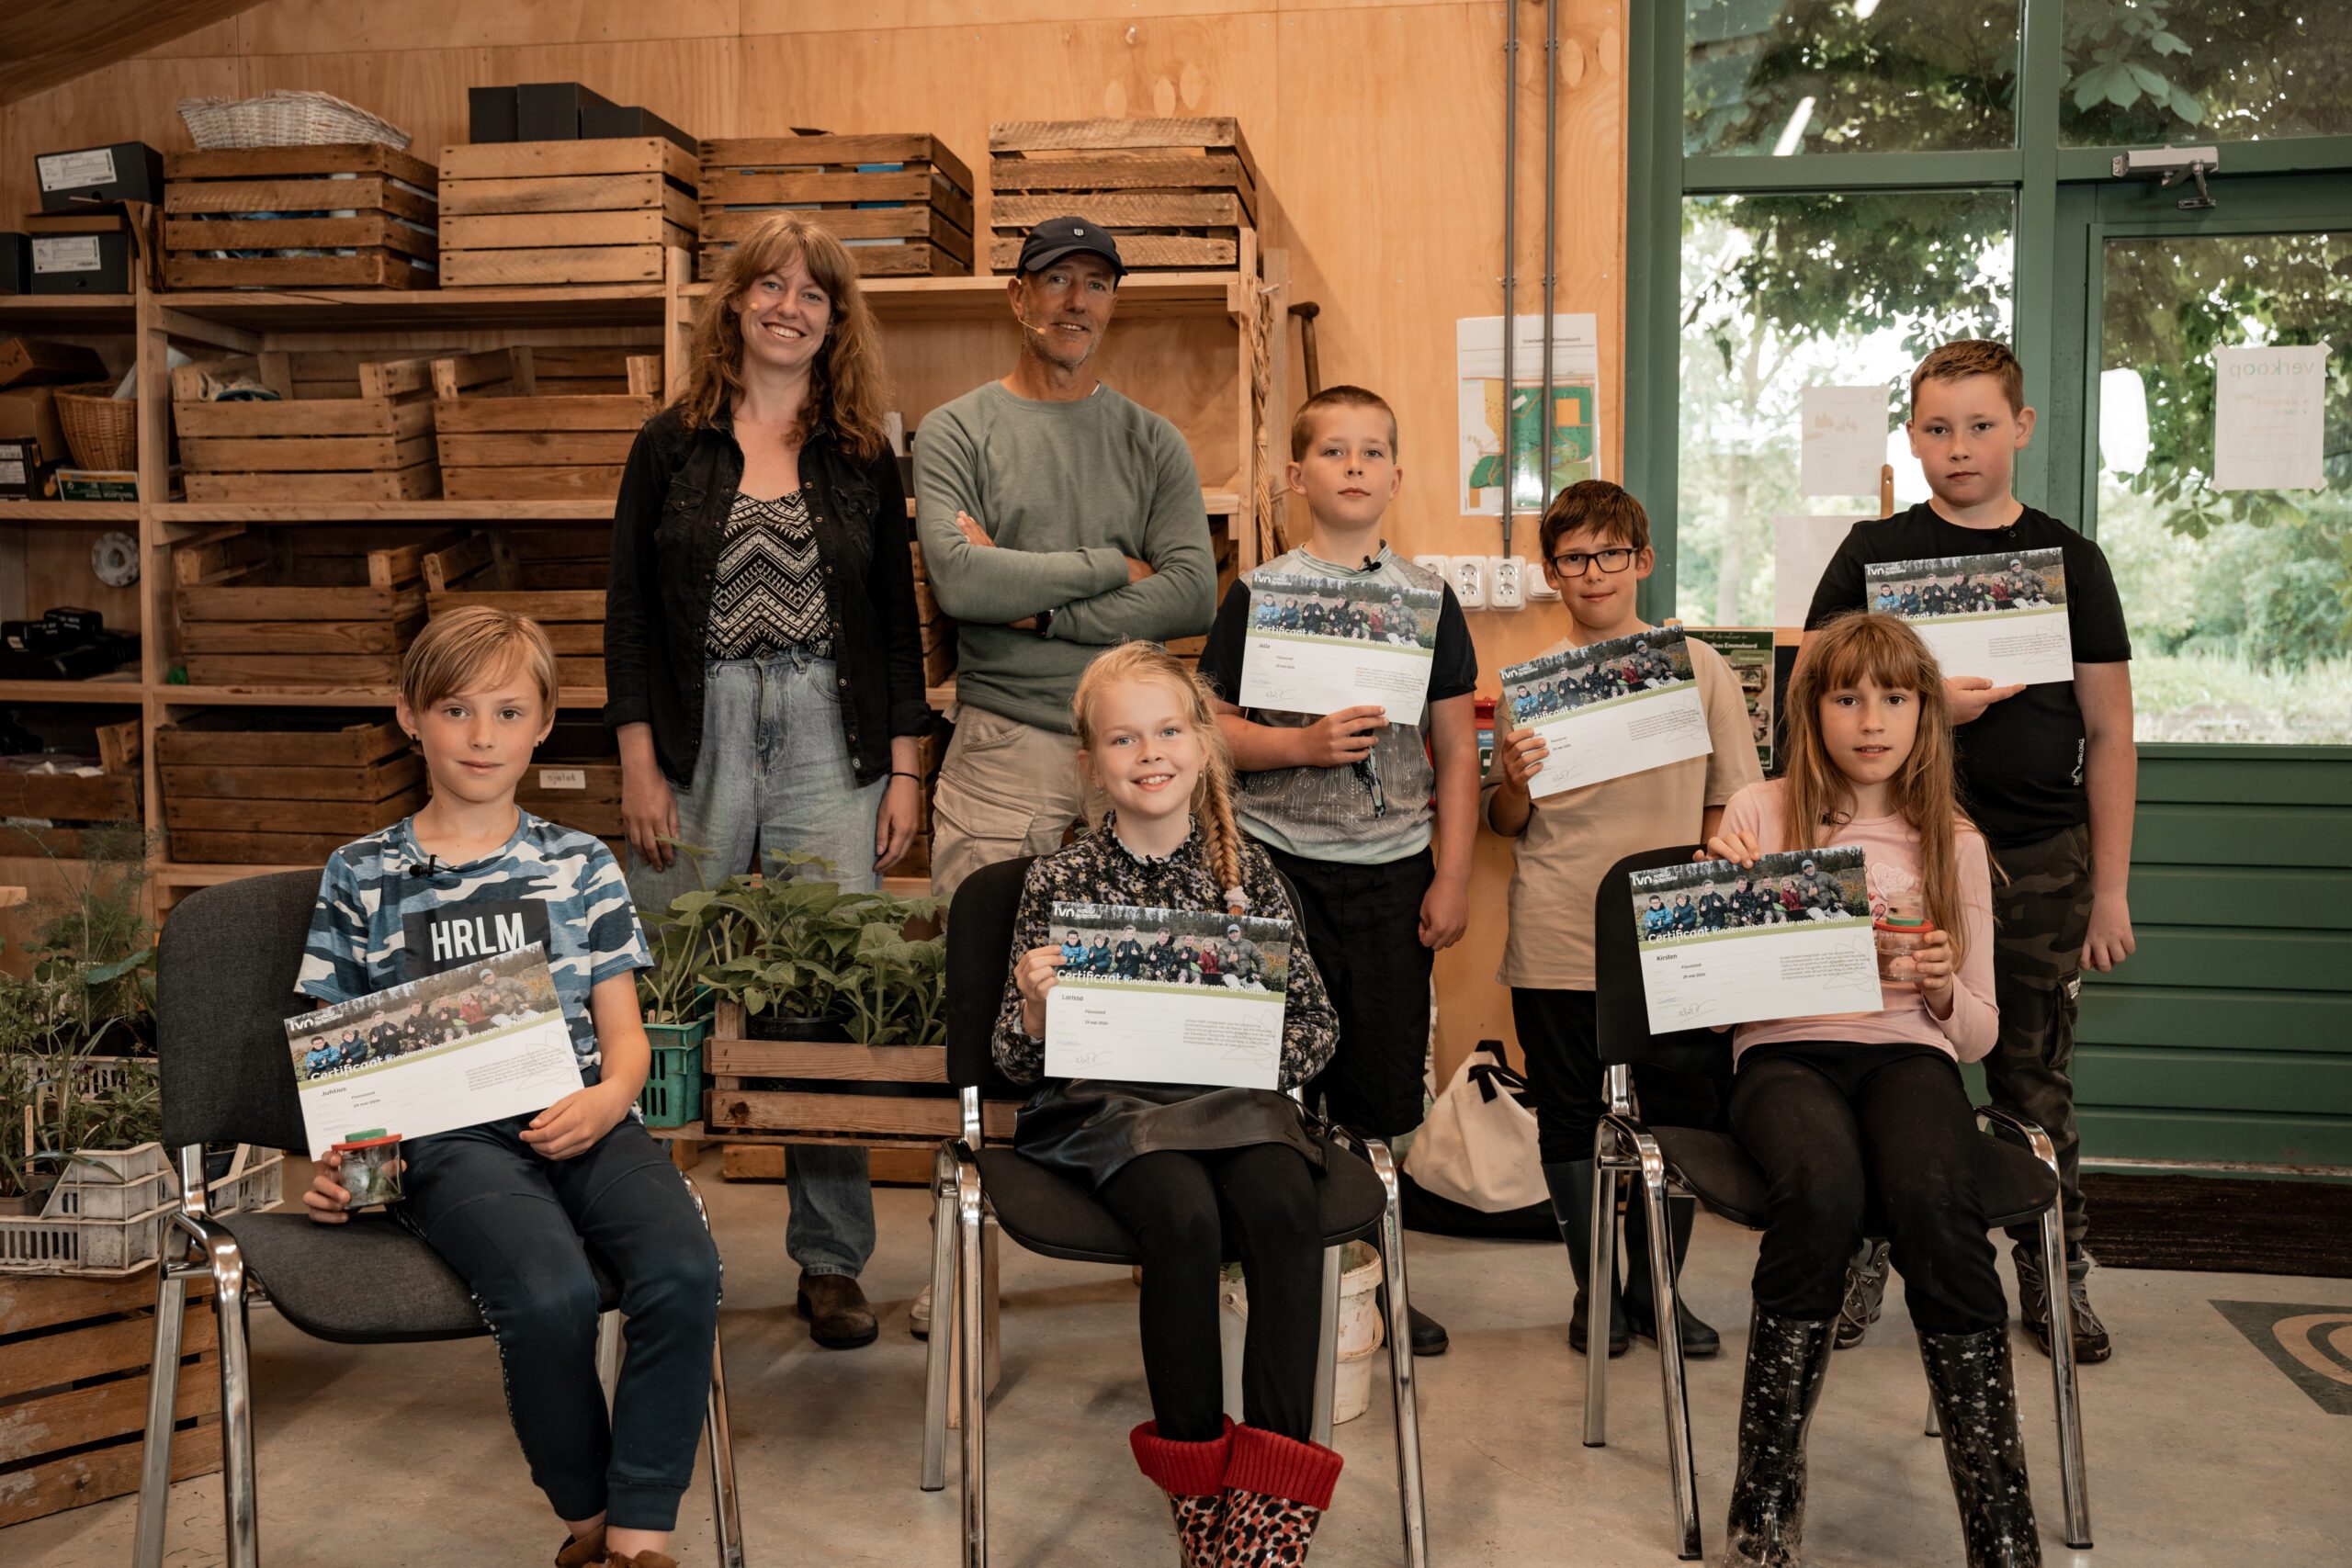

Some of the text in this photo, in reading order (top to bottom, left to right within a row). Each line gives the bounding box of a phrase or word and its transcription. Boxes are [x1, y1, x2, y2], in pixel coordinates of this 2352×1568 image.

[1894, 611, 1931, 622] tificaat
[1255, 624, 1308, 638] Certificaat
[1724, 641, 1758, 649] Emmeloord
[1520, 705, 1570, 727] Certificaat
[430, 912, 526, 962] HRLM
[1647, 925, 1710, 944] Certificaat
[1713, 919, 1795, 936] Kinderambassadeur
[1797, 919, 1814, 927] van
[1826, 915, 1856, 924] Natuur
[1657, 953, 1678, 962] Kirsten
[1057, 969, 1122, 986] Certificaat
[1124, 976, 1208, 990] Kinderambassadeur
[1210, 984, 1228, 992] van
[1240, 986, 1272, 997] Natuur
[311, 1055, 384, 1082] Certificaat
[387, 1032, 479, 1064] Kinderambassadeur
[481, 1027, 499, 1037] van
[513, 1011, 546, 1027] Natuur
[322, 1087, 347, 1097] Juhlius
